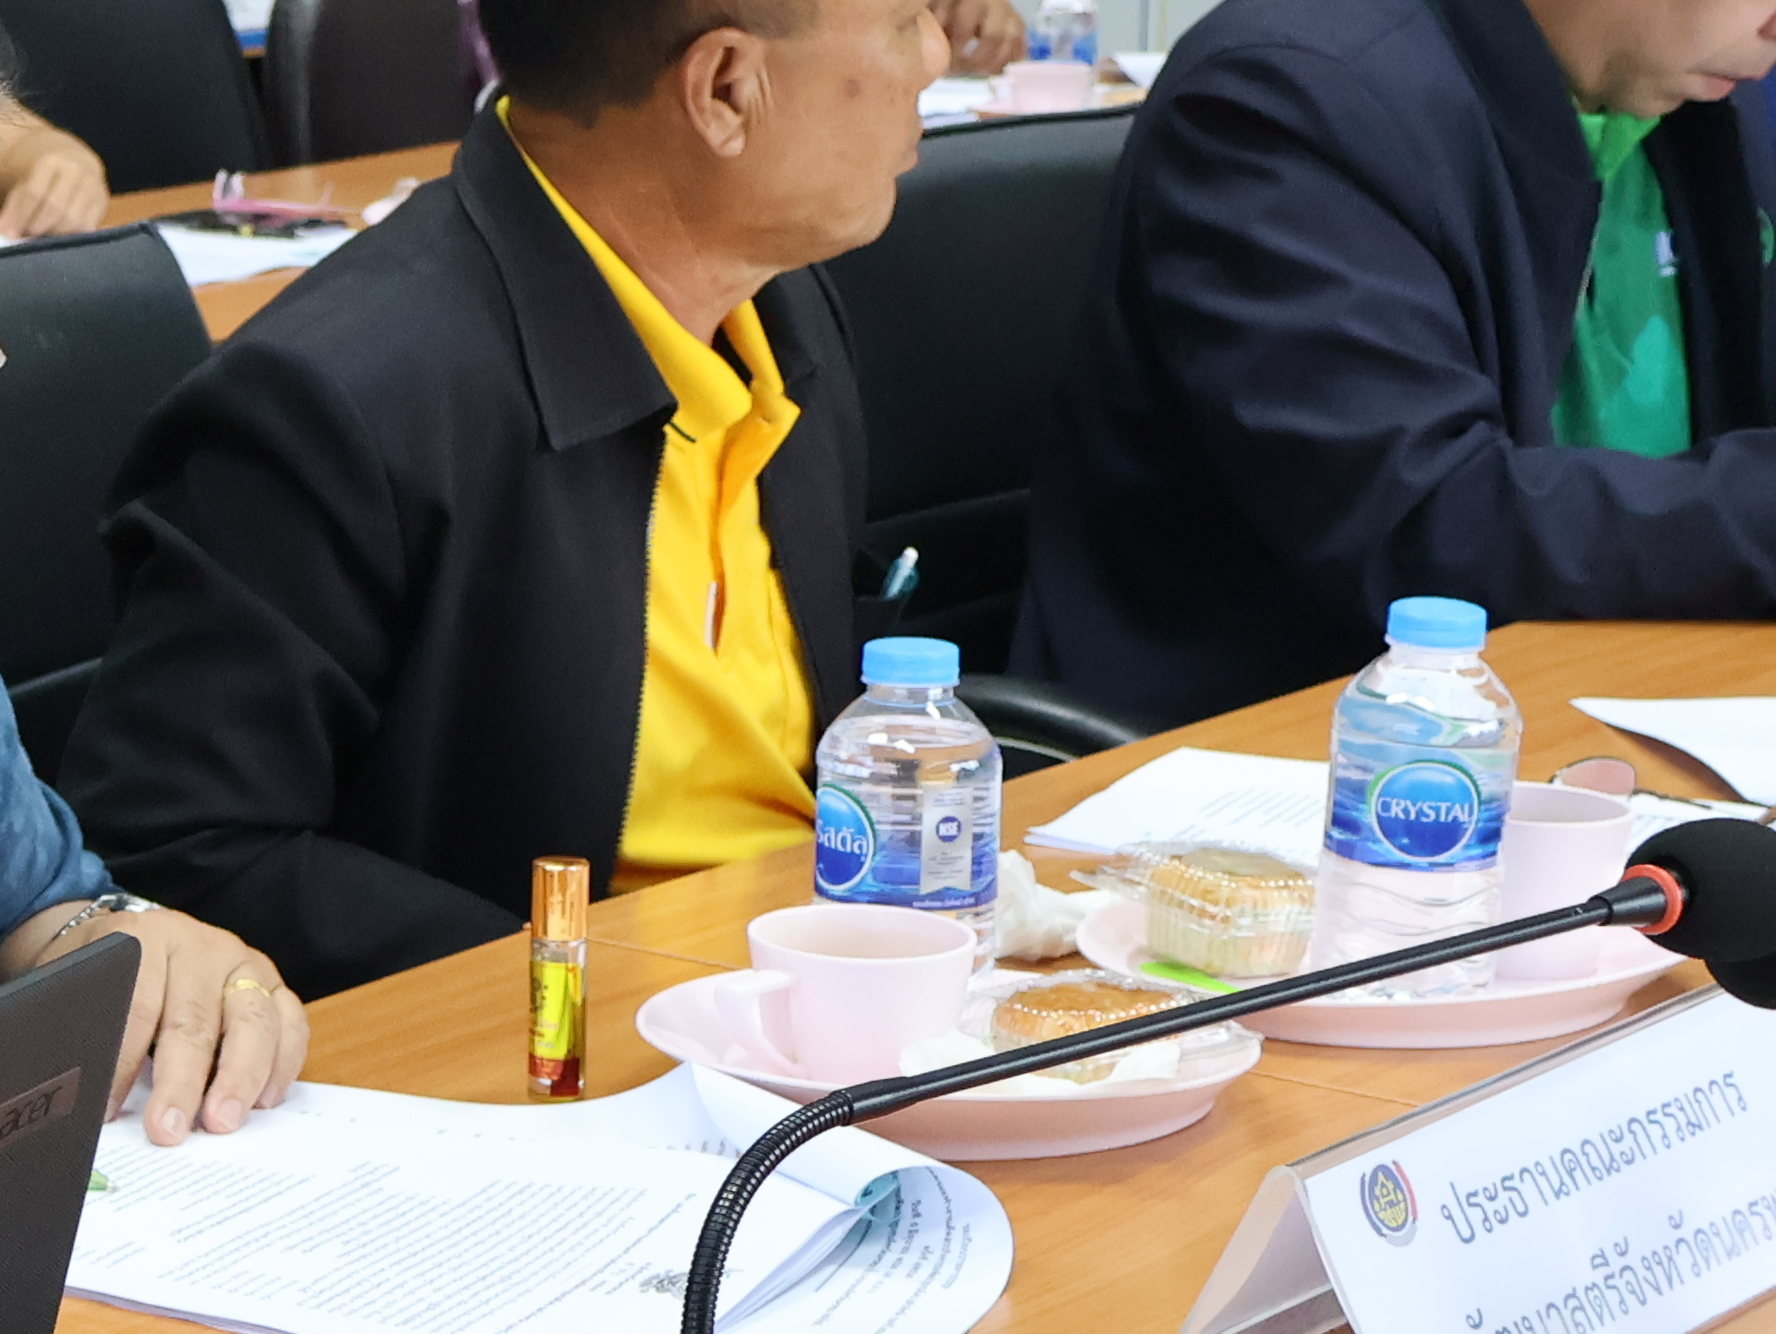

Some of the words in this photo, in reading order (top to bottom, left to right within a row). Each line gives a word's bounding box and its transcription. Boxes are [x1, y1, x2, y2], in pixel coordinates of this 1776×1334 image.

[1376, 796, 1473, 824] CRYSTAL
[1440, 1070, 1748, 1244] ประธานคณะกรรมการ
